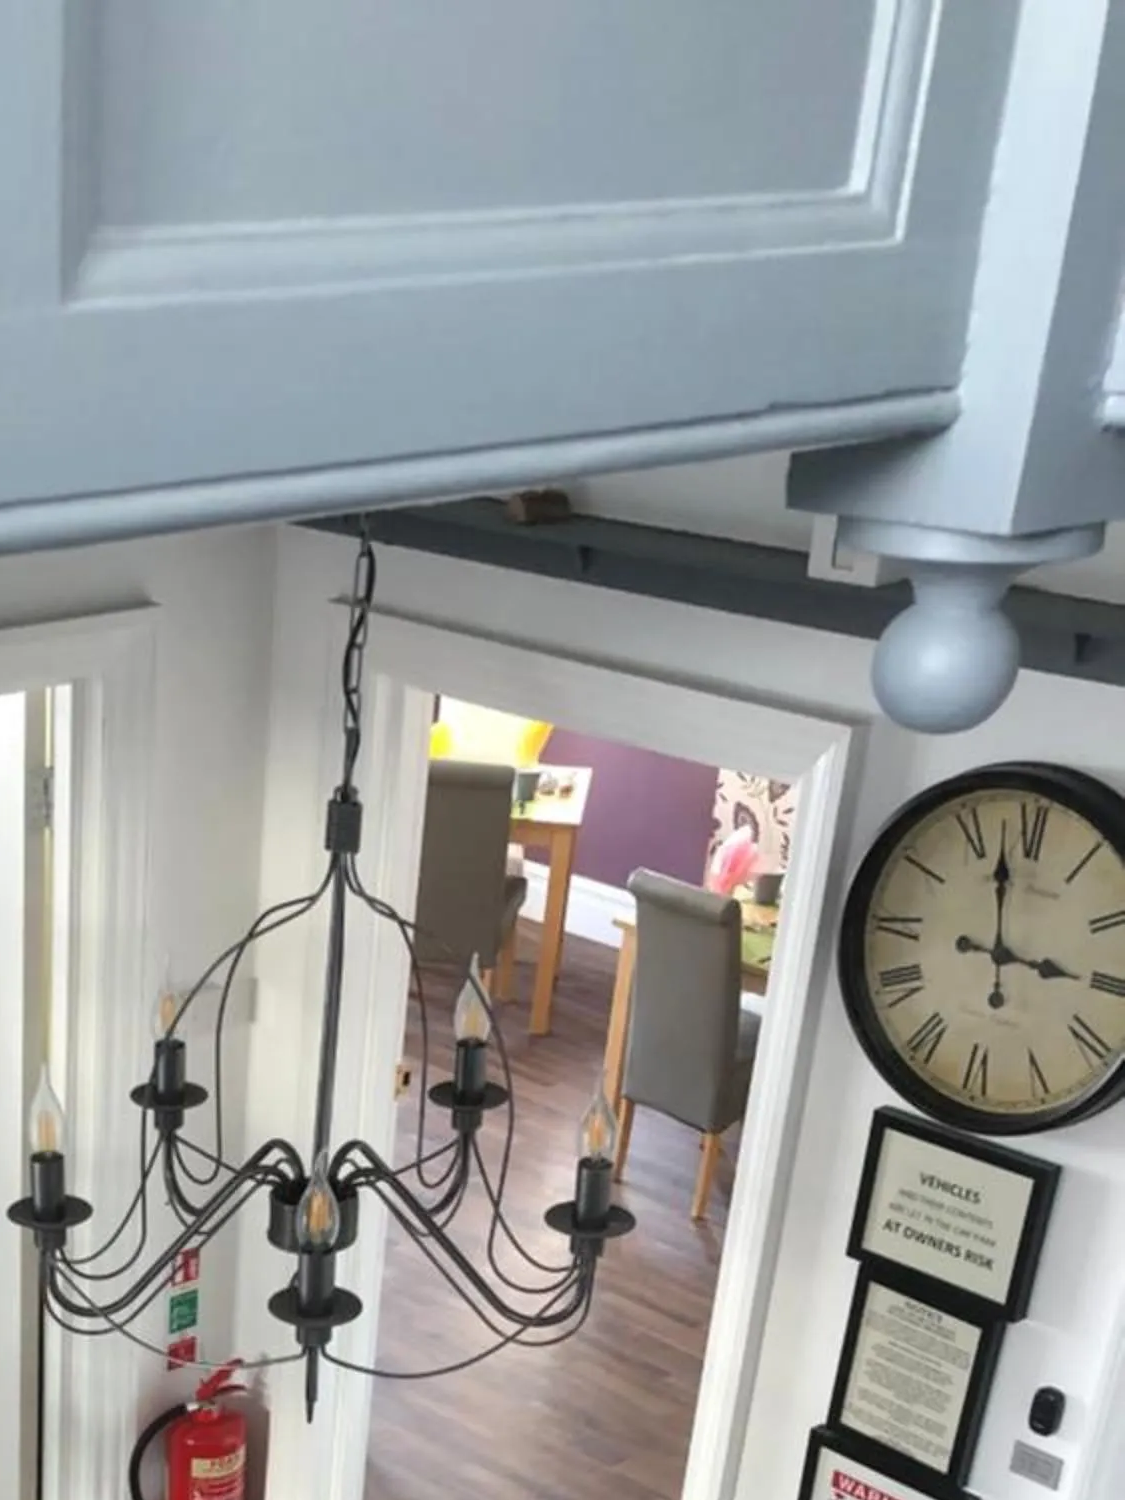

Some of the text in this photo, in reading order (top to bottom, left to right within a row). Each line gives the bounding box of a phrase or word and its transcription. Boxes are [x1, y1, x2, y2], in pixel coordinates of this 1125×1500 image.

[919, 1170, 982, 1205] VEHICLES
[881, 1218, 994, 1272] AT OWNERS RISK
